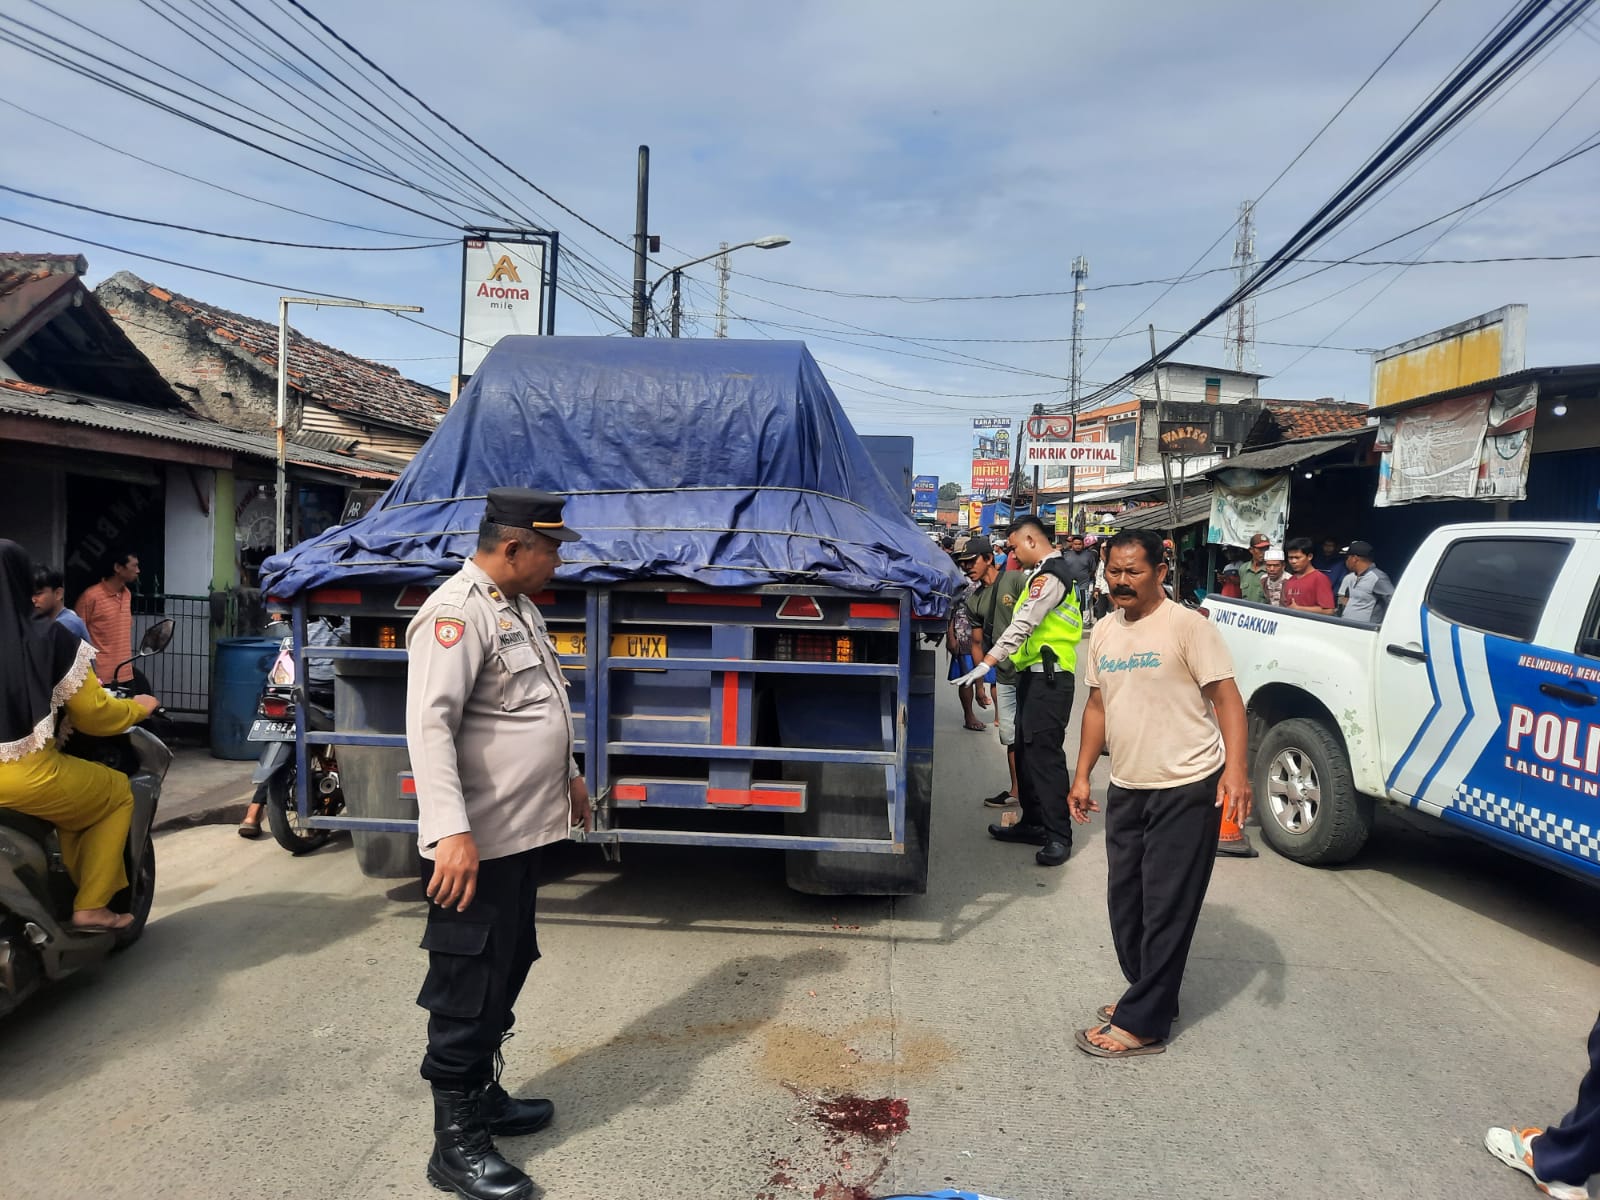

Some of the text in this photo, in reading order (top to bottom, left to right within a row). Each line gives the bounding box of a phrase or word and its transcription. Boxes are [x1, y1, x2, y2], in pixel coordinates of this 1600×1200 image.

[477, 282, 529, 300] Aroma
[490, 301, 513, 310] mile
[1029, 447, 1117, 461] RIKRIK OPTIKAL
[973, 465, 1008, 476] MARU
[1216, 608, 1278, 636] UNIT GAKKUM
[627, 636, 662, 658] UWX
[1518, 655, 1574, 679] MELINDUNGI,
[1507, 704, 1600, 774] POLI
[1504, 756, 1598, 797] LALU LIN
